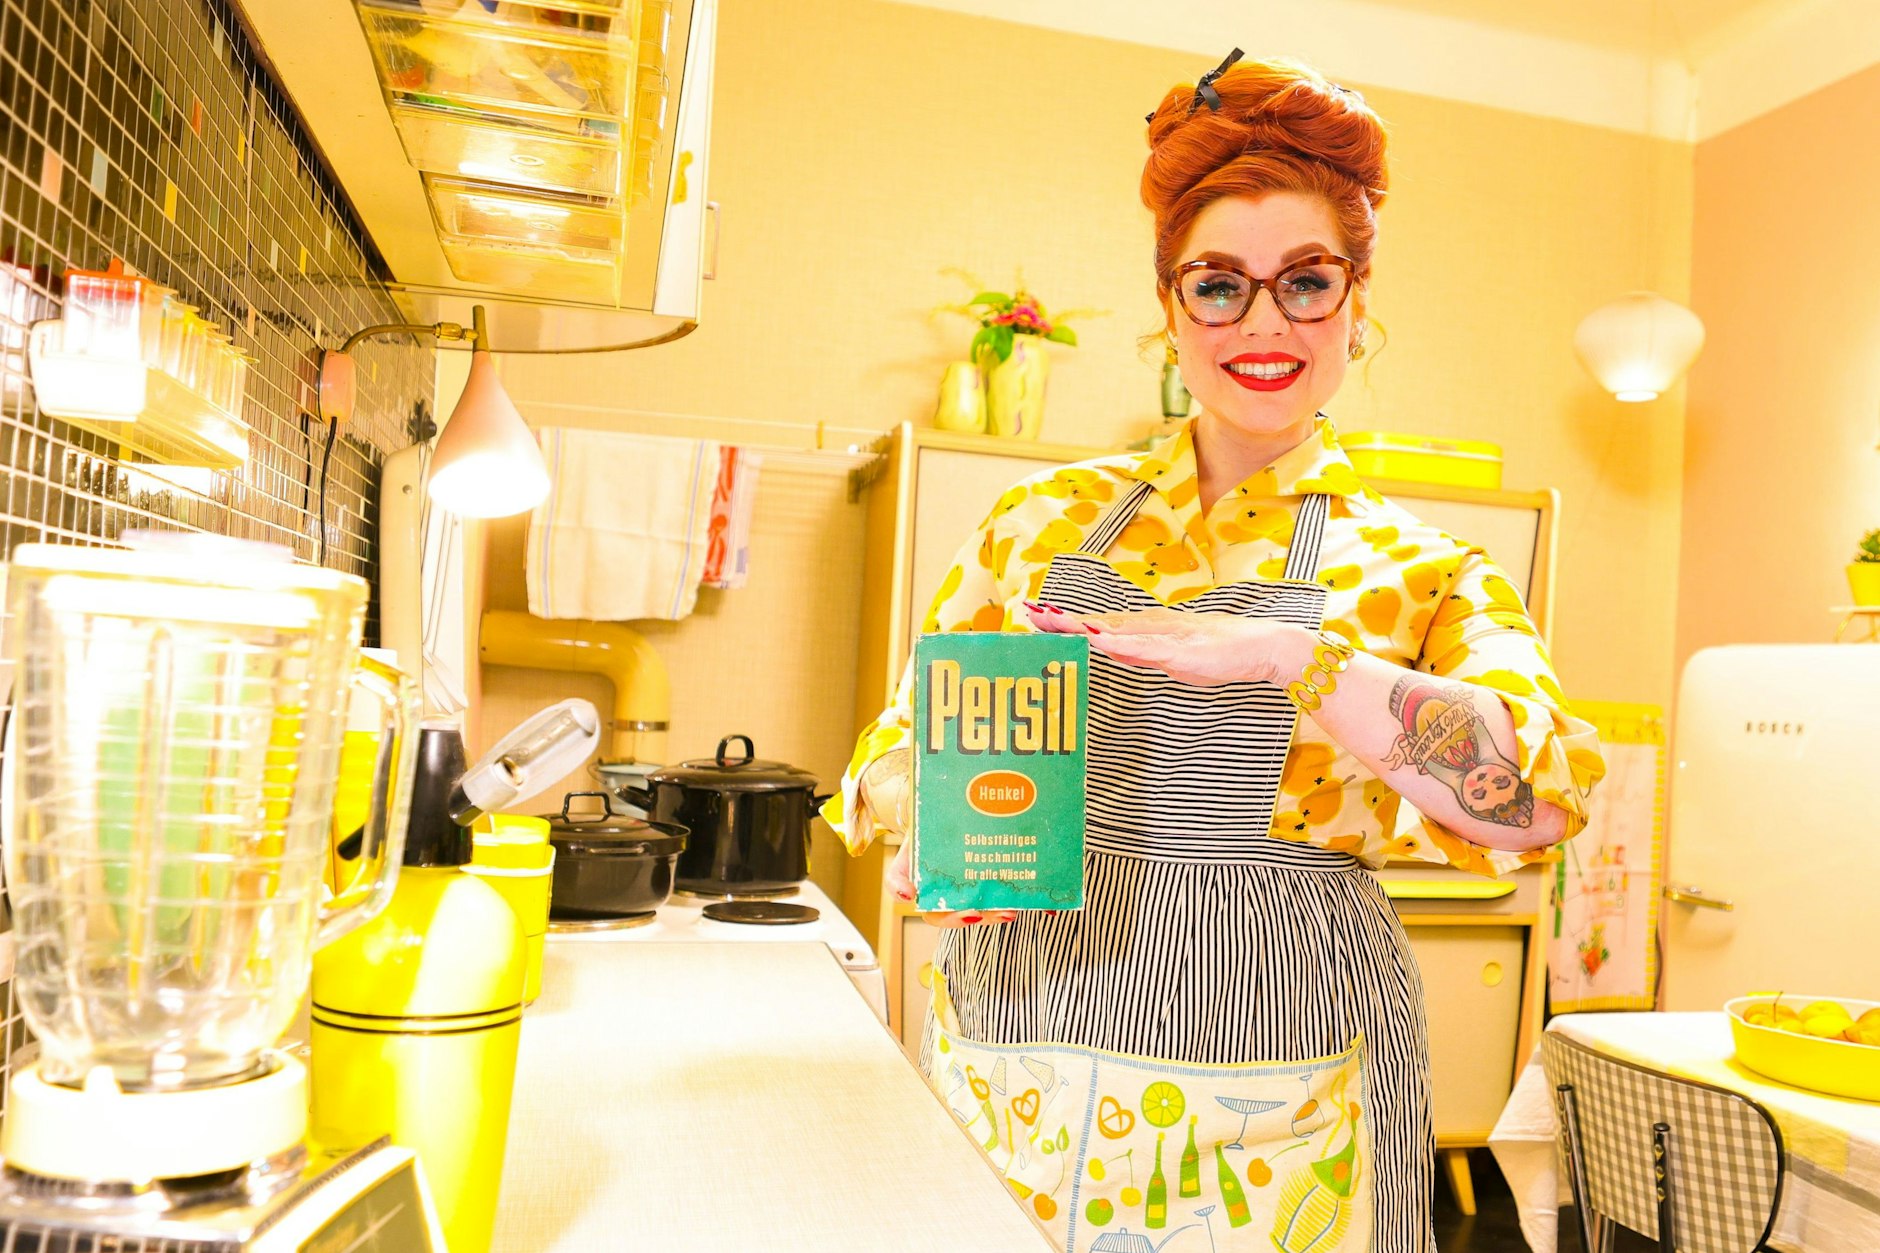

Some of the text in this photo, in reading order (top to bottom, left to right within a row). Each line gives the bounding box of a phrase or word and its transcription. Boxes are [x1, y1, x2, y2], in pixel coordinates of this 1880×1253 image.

[927, 659, 1078, 755] Persil
[979, 785, 1025, 801] Henkel
[964, 833, 1037, 847] Selbsttätiges
[964, 851, 1037, 863] Waschmittel
[964, 868, 1037, 881] für alle Wäsche
